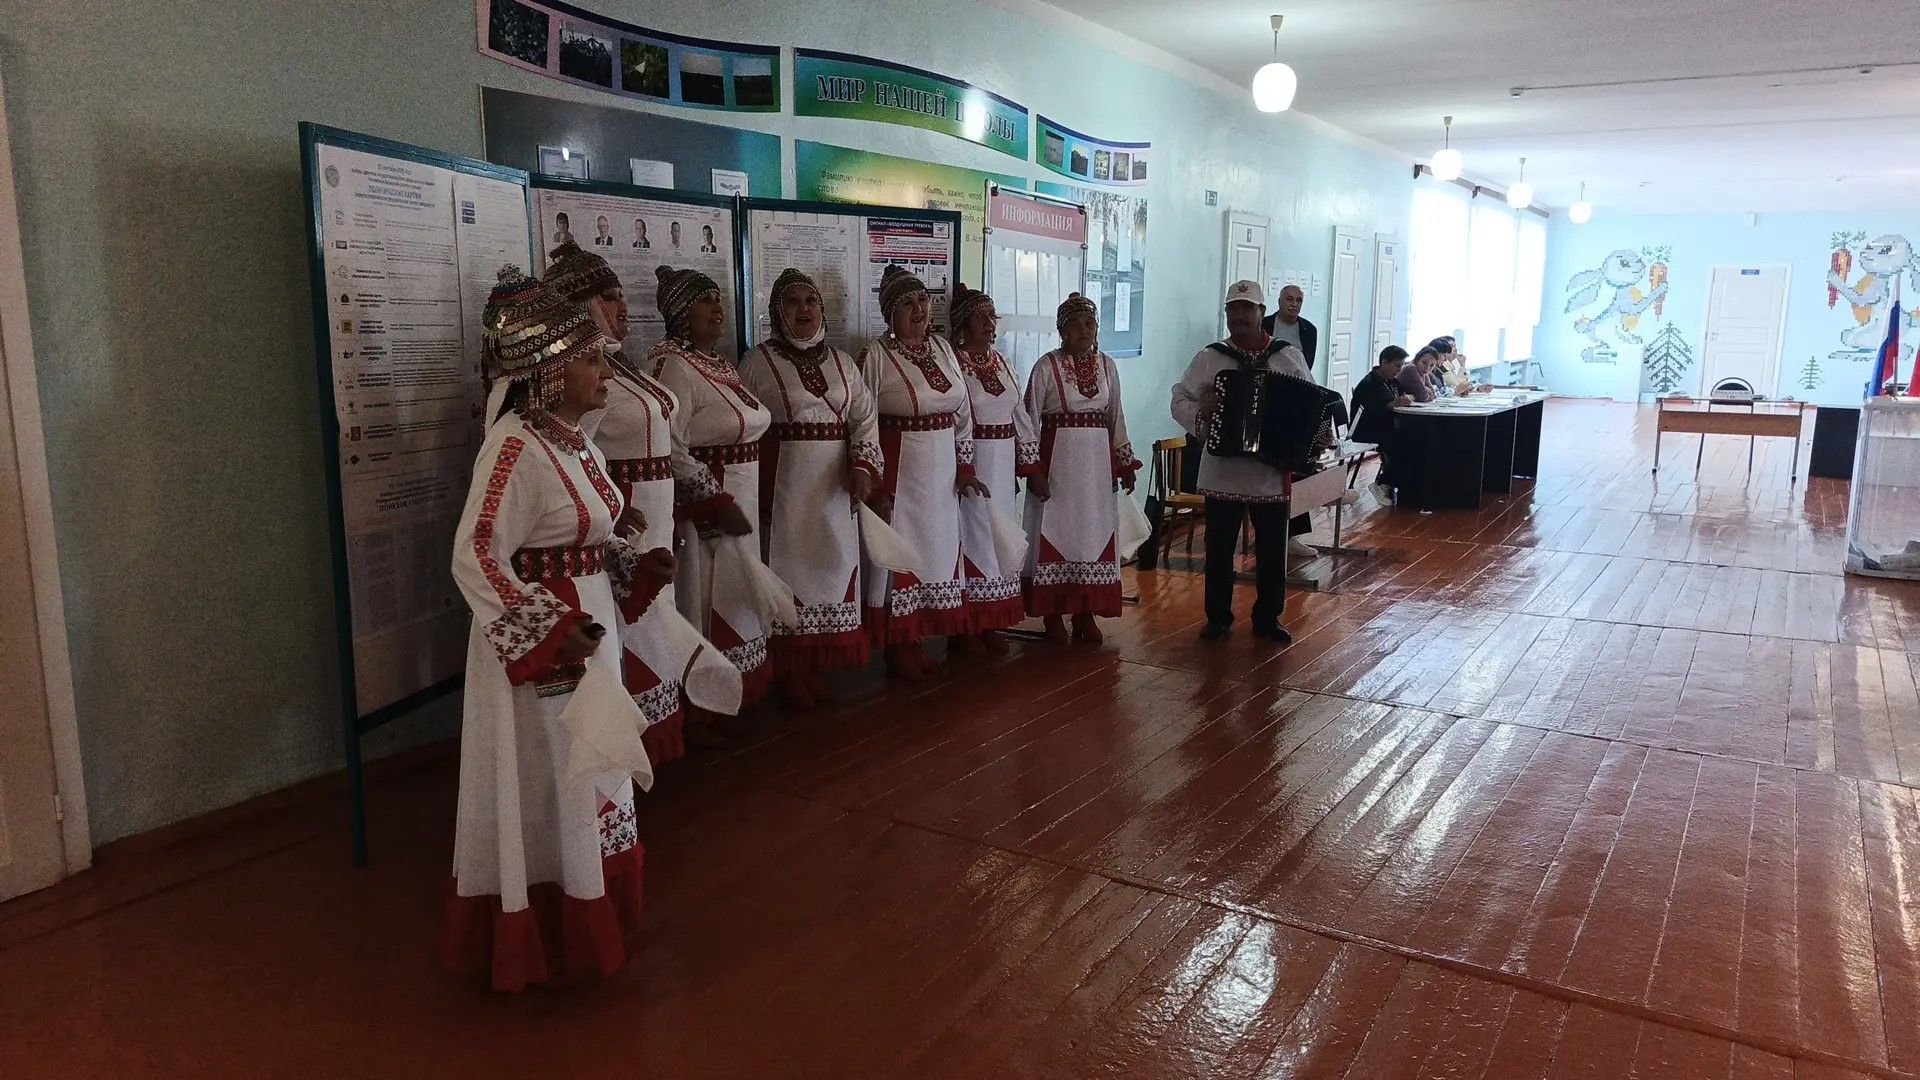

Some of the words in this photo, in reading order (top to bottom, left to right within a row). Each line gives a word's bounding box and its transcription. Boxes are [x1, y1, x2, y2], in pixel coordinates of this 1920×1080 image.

[817, 75, 866, 102] МИР
[874, 81, 947, 117] НАШЕЙ
[954, 100, 1015, 141] ШОЛЫ
[1001, 203, 1073, 232] ИНФОРМАЦИЯ
